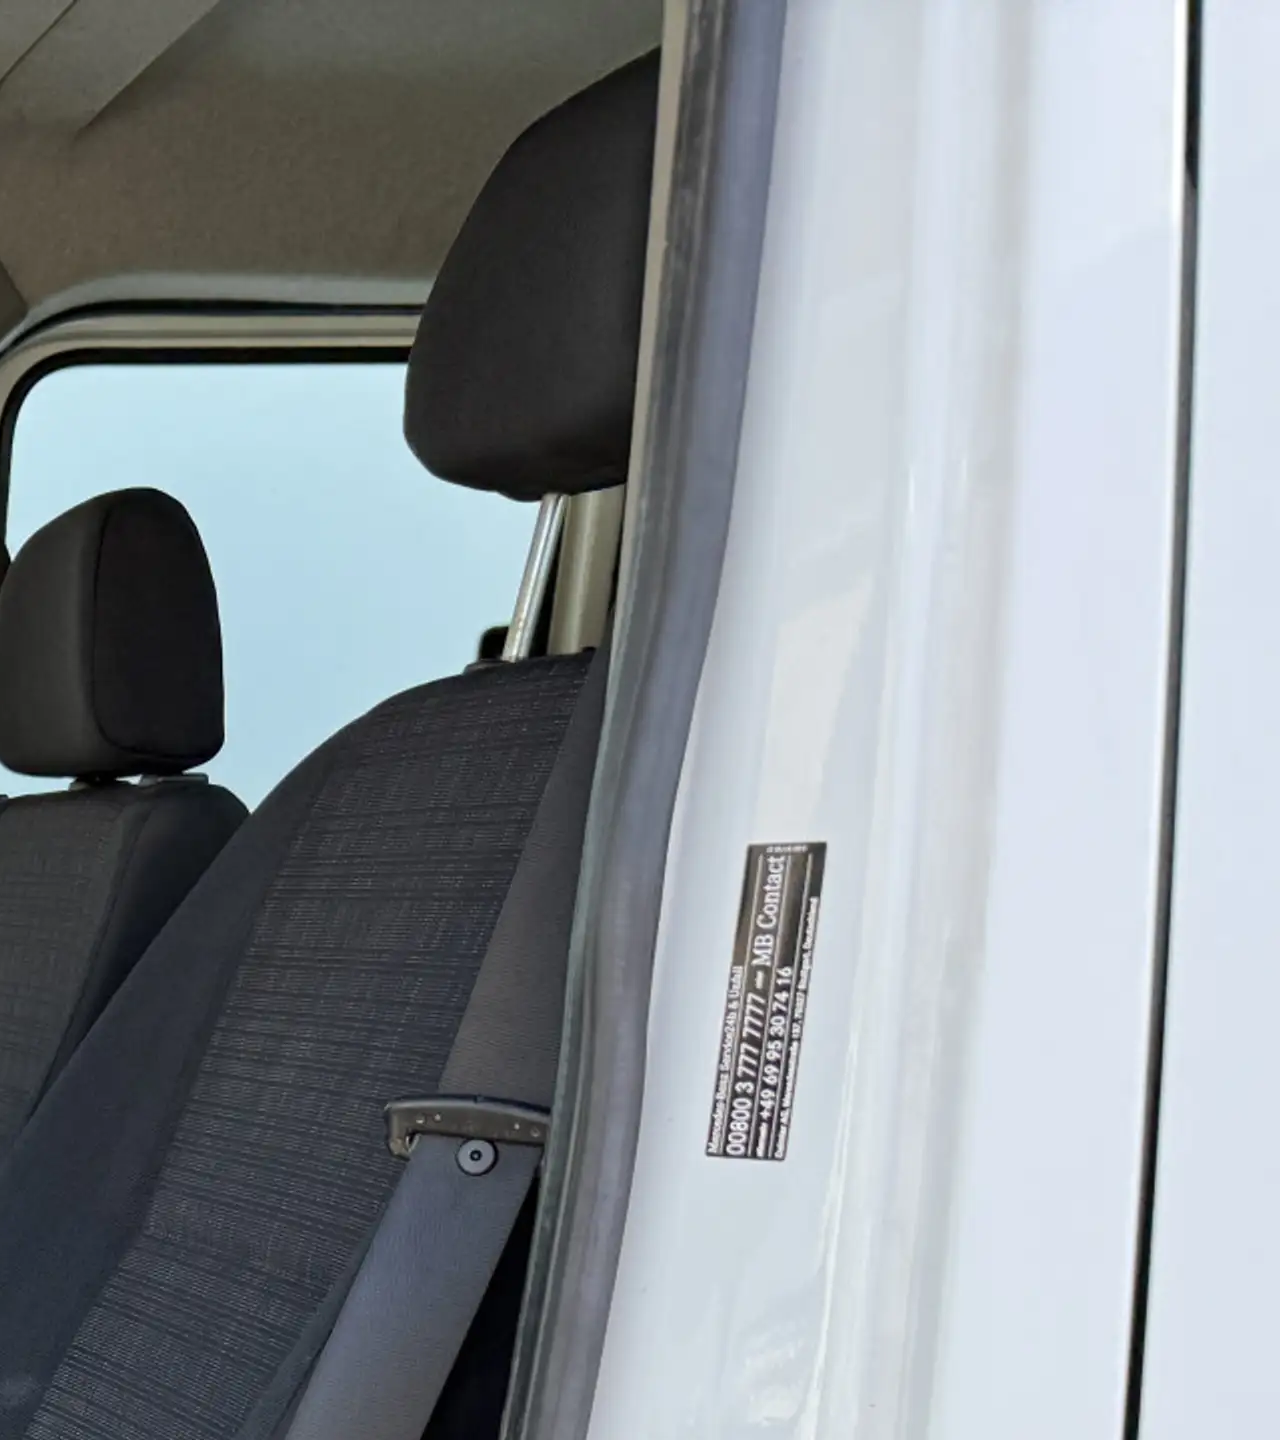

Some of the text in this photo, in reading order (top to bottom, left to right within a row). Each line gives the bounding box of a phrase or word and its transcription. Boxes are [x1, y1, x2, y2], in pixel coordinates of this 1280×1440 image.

[756, 856, 785, 929] Contact
[751, 934, 775, 967] MB
[777, 967, 792, 986] 16
[773, 991, 788, 1011] 74
[742, 992, 765, 1038] 7777
[769, 1016, 785, 1037] 30
[738, 1042, 759, 1078] 777
[767, 1040, 783, 1061] 95
[735, 1081, 755, 1094] 3
[764, 1065, 779, 1085] 69
[760, 1089, 775, 1119] +49
[726, 1098, 751, 1155] 00800
